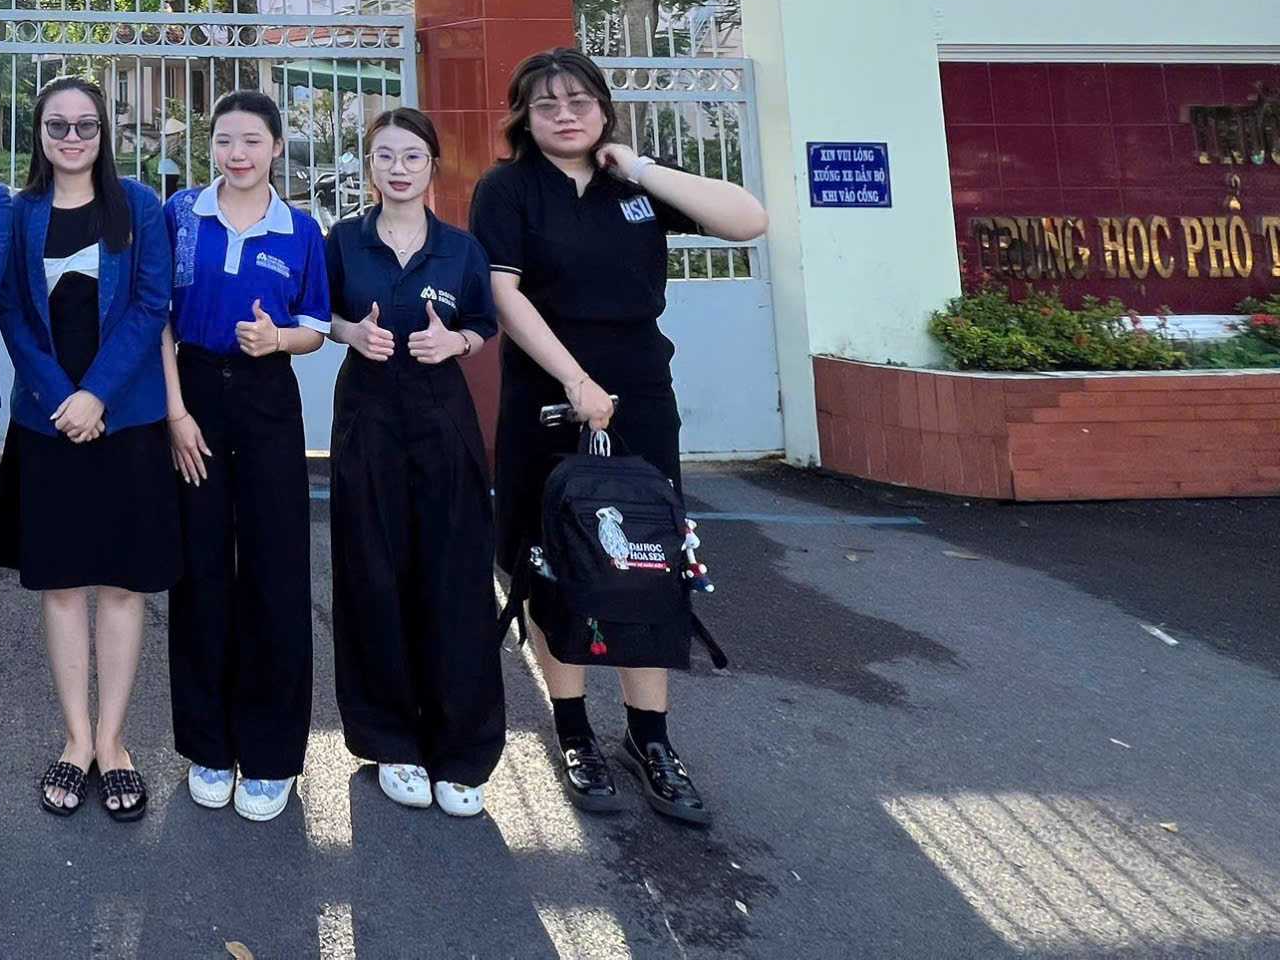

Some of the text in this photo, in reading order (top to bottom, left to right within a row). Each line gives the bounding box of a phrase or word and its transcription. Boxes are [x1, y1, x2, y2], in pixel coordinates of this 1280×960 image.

[821, 149, 835, 162] XIN
[837, 149, 852, 162] VUI
[842, 170, 854, 182] XE
[822, 190, 838, 202] KHI
[620, 196, 655, 221] HSU
